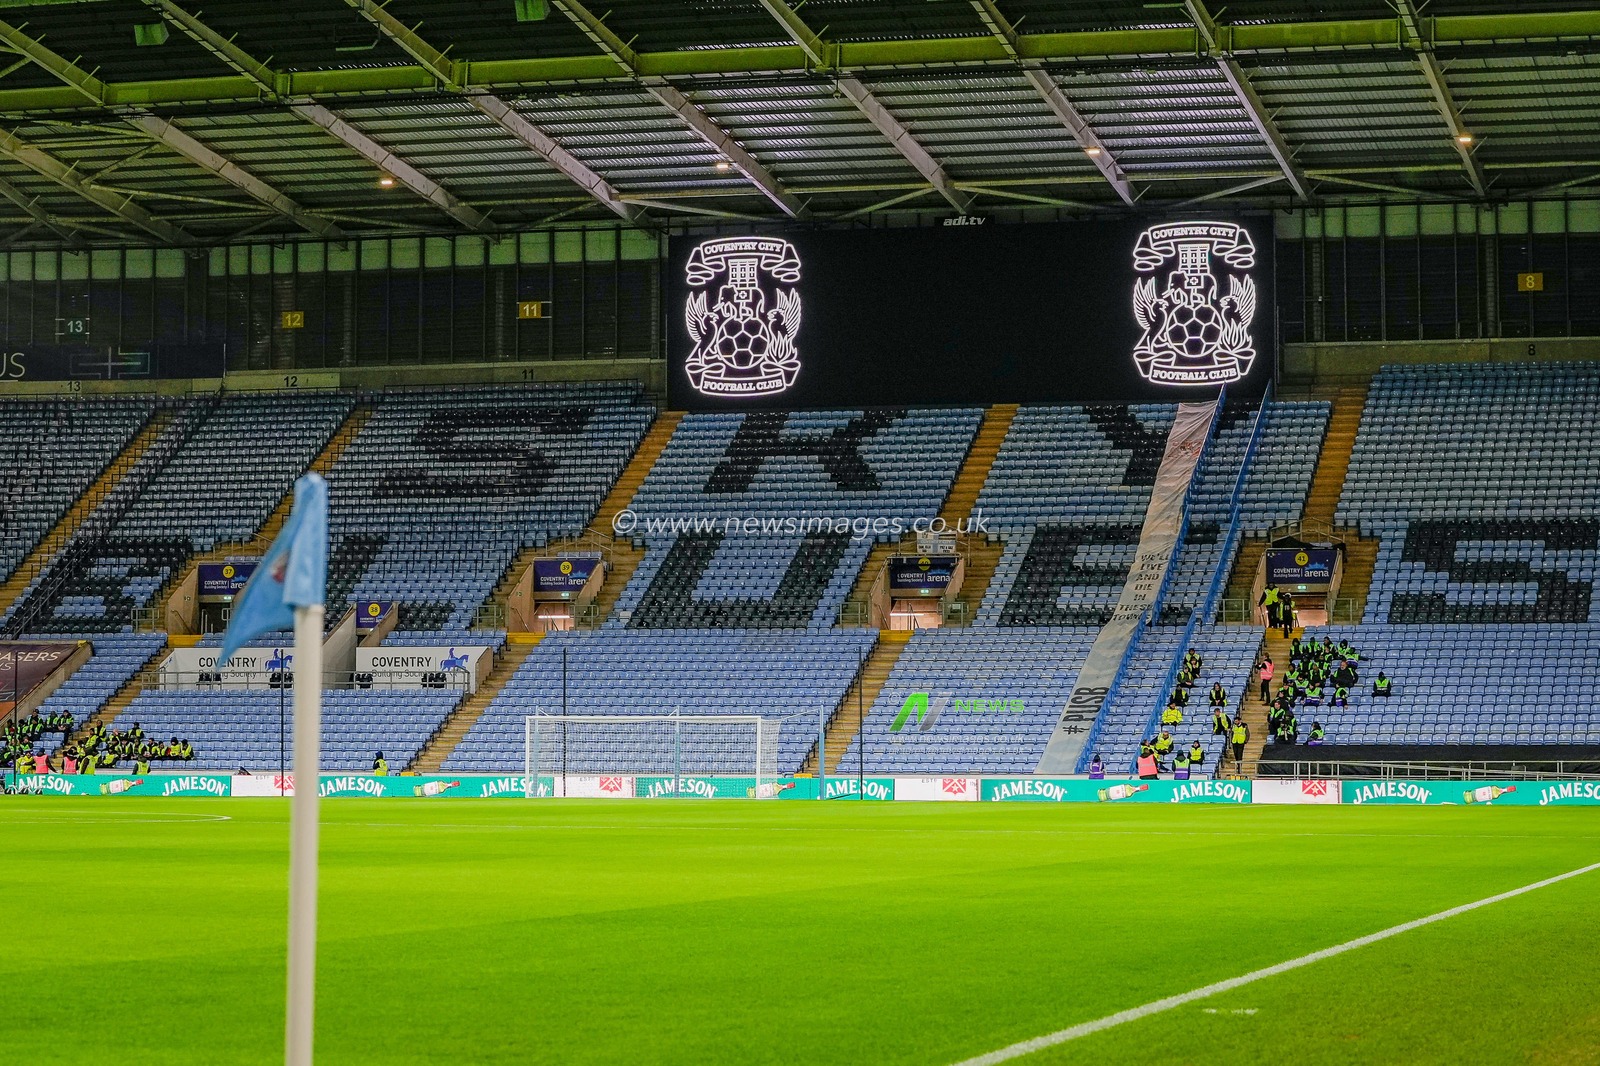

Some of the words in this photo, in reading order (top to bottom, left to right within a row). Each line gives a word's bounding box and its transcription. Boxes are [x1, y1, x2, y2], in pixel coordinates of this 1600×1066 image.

[943, 215, 986, 226] adi.tv
[1152, 226, 1209, 240] COVENTRY
[1209, 226, 1236, 237] CITY
[704, 241, 757, 254] COVENTRY
[758, 241, 782, 252] CITY
[1525, 275, 1535, 288] 8
[523, 303, 538, 317] 11
[285, 313, 301, 326] 12
[67, 320, 83, 333] 13
[1527, 343, 1536, 356] 8
[521, 369, 535, 380] 11
[1152, 369, 1208, 380] FOOTBALL
[1208, 367, 1236, 379] CLUB
[67, 381, 81, 392] 13
[283, 375, 298, 387] 12
[703, 380, 755, 391] FOOTBALL
[756, 379, 782, 390] CLUB
[1140, 563, 1164, 571] LIVE
[1136, 573, 1159, 581] AND
[1135, 583, 1154, 591] DIE
[1134, 593, 1146, 601] IN
[1119, 603, 1154, 611] THESE
[0, 652, 61, 662] ASERS
[199, 657, 257, 668] COVNTRY
[372, 656, 432, 667] COVENTRY
[17, 775, 74, 795] AMESON
[162, 776, 228, 797] JAMESON
[318, 776, 386, 797] JAMESON
[646, 778, 718, 799] JAMESON
[992, 780, 1067, 802] JAMESON
[1170, 781, 1248, 803] JAMESON
[1353, 782, 1432, 805] JAMESON
